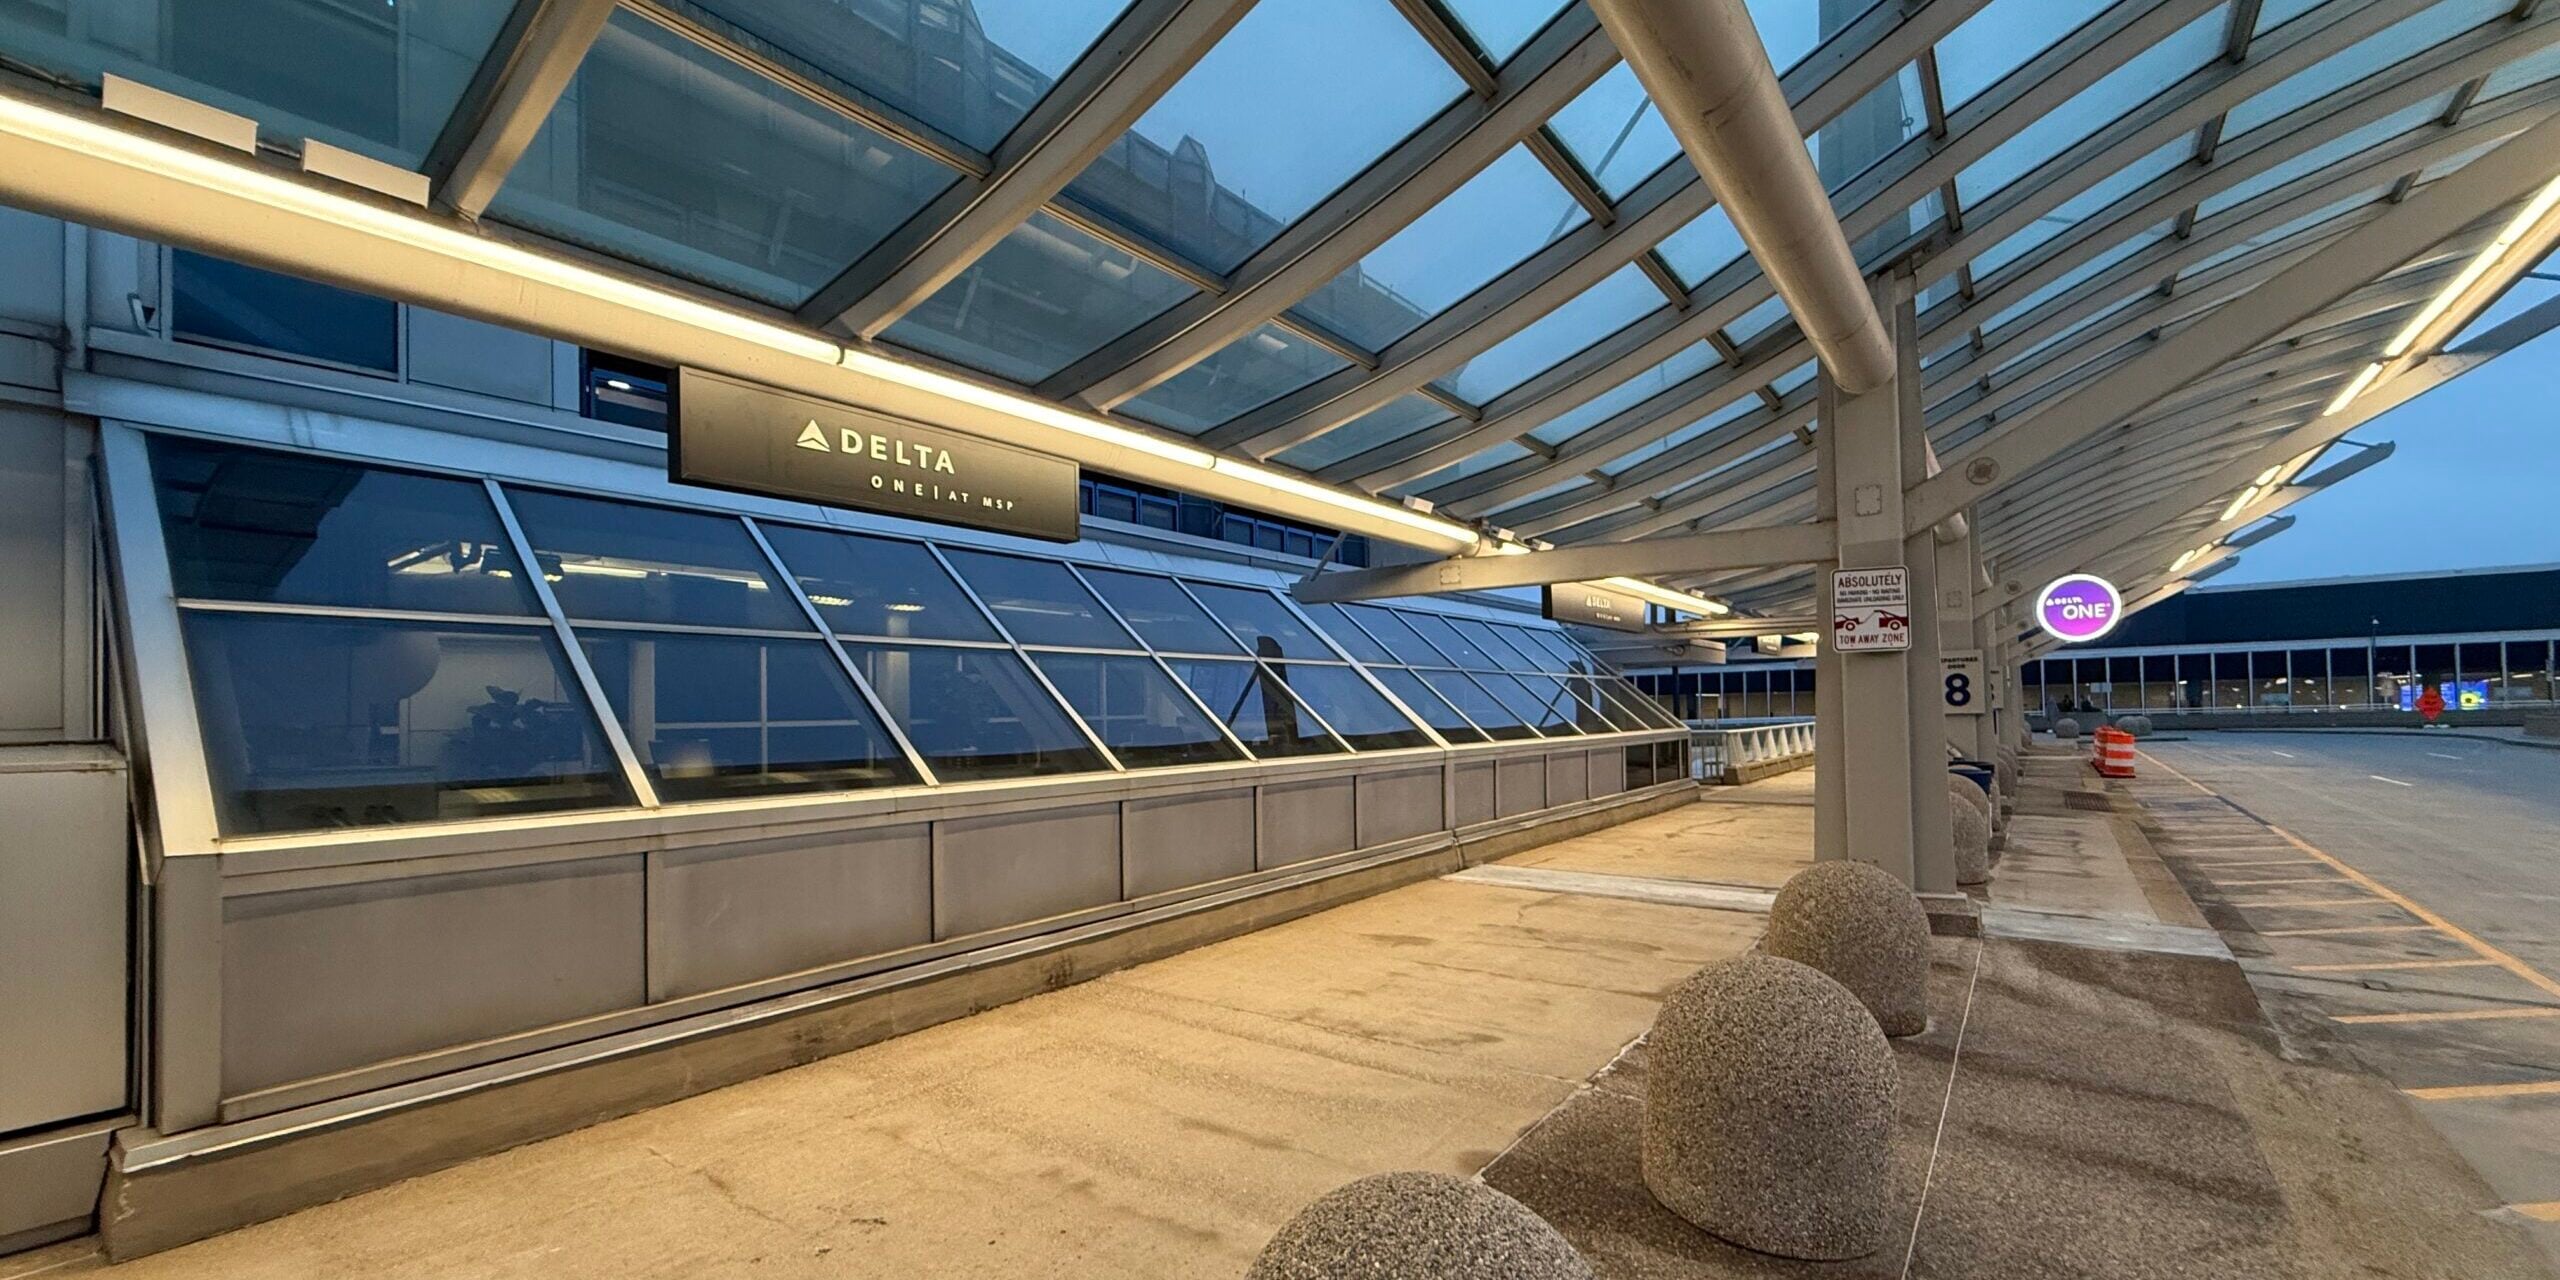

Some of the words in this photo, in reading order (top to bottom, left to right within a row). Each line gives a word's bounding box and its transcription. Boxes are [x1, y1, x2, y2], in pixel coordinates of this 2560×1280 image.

[841, 428, 955, 474] DELTA
[871, 475, 924, 497] ONE
[948, 491, 969, 504] AT
[983, 497, 1014, 511] MSP
[1838, 574, 1902, 588] ABSOLUTELY
[2063, 603, 2106, 619] ONE
[1839, 634, 1856, 645] TOW
[1858, 633, 1879, 645] AWAY
[1882, 632, 1905, 643] ZONE
[1945, 673, 1971, 707] 8
